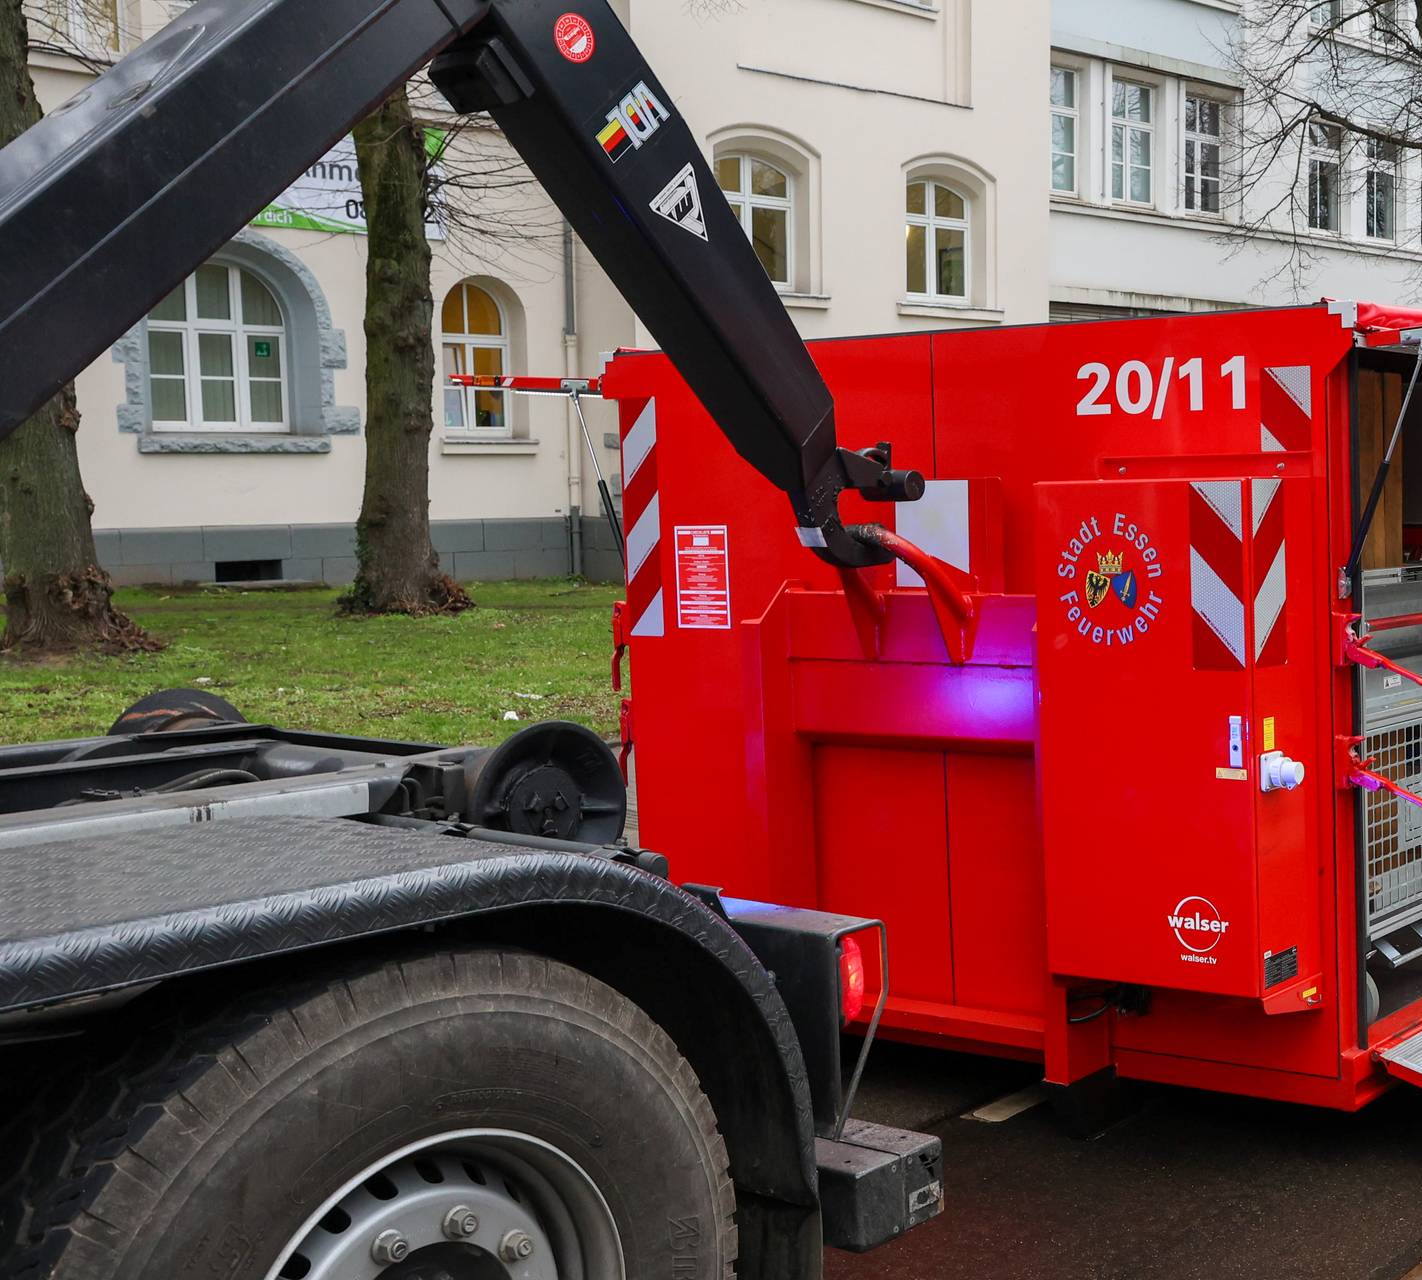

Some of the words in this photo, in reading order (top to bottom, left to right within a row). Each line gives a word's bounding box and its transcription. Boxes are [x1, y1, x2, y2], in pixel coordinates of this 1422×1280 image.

[1076, 356, 1246, 420] 20/11
[1057, 516, 1101, 579] Stadt
[1113, 512, 1162, 578] Essen
[1060, 590, 1163, 646] Feuerwehr
[1167, 911, 1229, 933] walser
[1180, 953, 1217, 965] walser.tv
